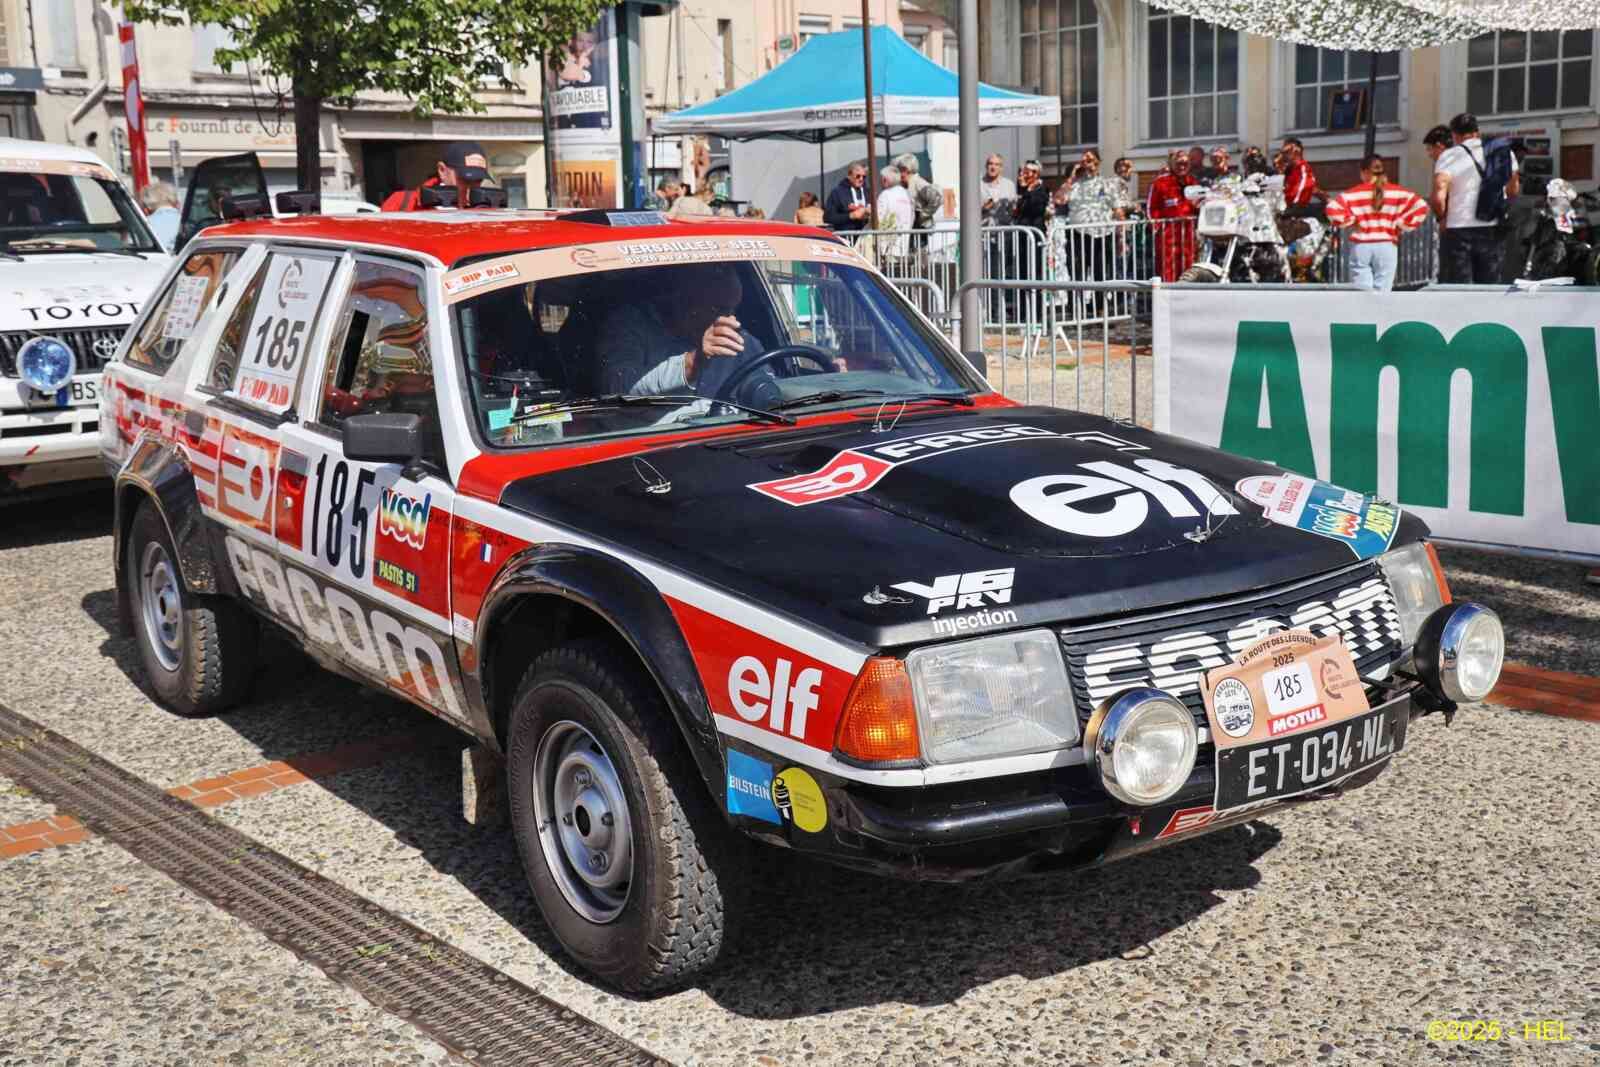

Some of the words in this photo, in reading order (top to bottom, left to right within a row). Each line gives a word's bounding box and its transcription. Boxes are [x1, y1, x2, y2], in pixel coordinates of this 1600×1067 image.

[254, 315, 306, 371] 185
[873, 424, 1127, 459] FACO
[1009, 458, 1241, 538] elf
[310, 453, 376, 580] 185
[380, 486, 432, 550] vsd
[378, 559, 404, 587] PASTIS
[405, 573, 415, 592] 51
[890, 567, 1016, 599] V6
[926, 588, 1013, 615] PRV
[931, 608, 1018, 637] injection
[1239, 654, 1250, 666] LA
[1249, 641, 1271, 658] ROUTE
[1271, 636, 1284, 647] DES
[1273, 652, 1295, 668] 2025
[727, 655, 823, 740] elf
[1273, 673, 1303, 701] 185
[1271, 706, 1325, 734] MOTUL
[729, 775, 770, 801] BILSTEIN
